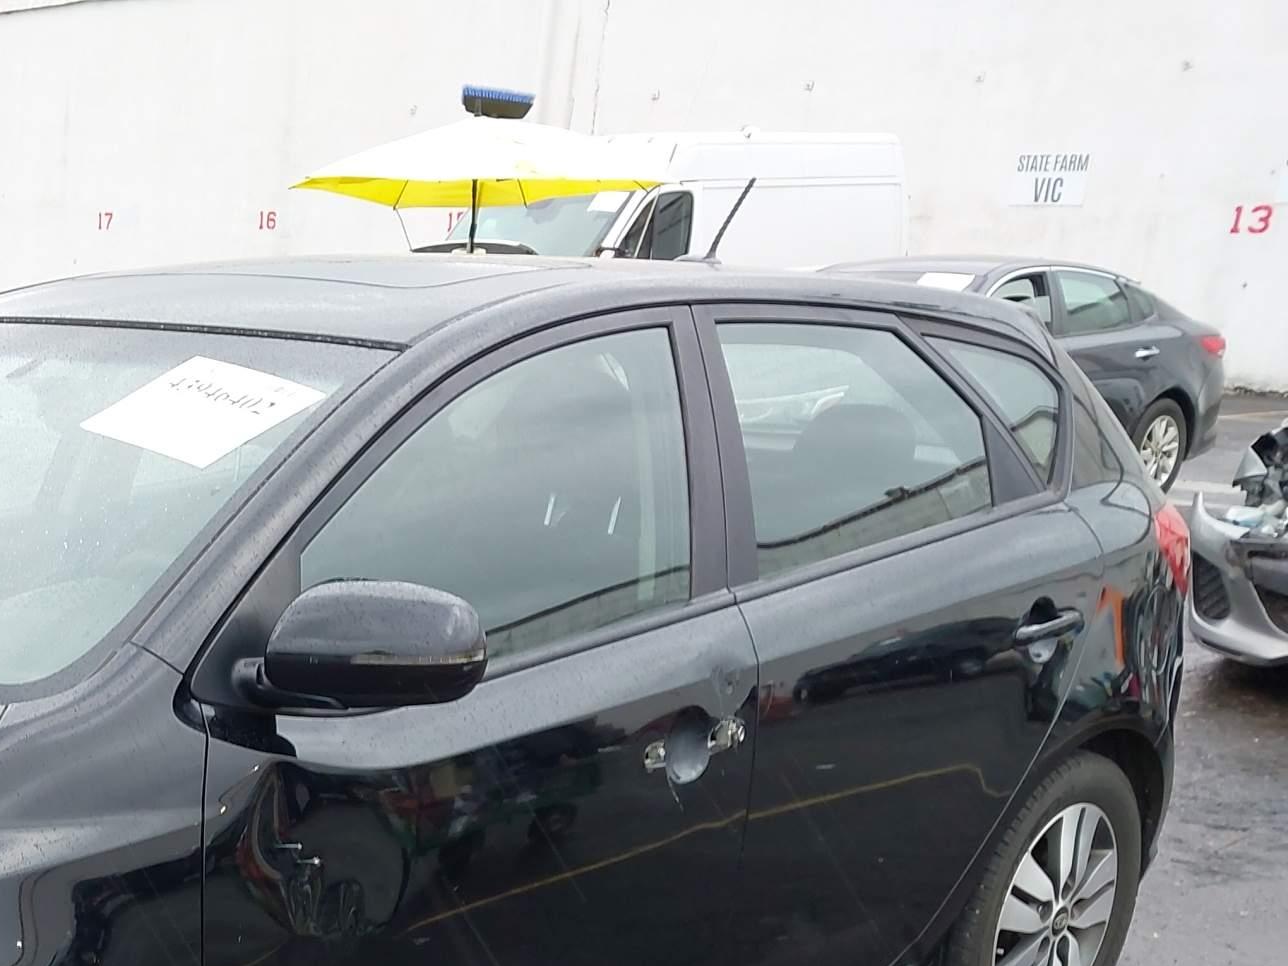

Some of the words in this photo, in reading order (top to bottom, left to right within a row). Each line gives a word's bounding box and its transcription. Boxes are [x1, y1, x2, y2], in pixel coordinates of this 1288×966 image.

[1017, 153, 1052, 173] STATE
[1053, 152, 1091, 173] FARM
[1033, 176, 1064, 203] VIC
[97, 212, 113, 230] 17
[257, 211, 277, 230] 16
[1230, 204, 1274, 234] 13
